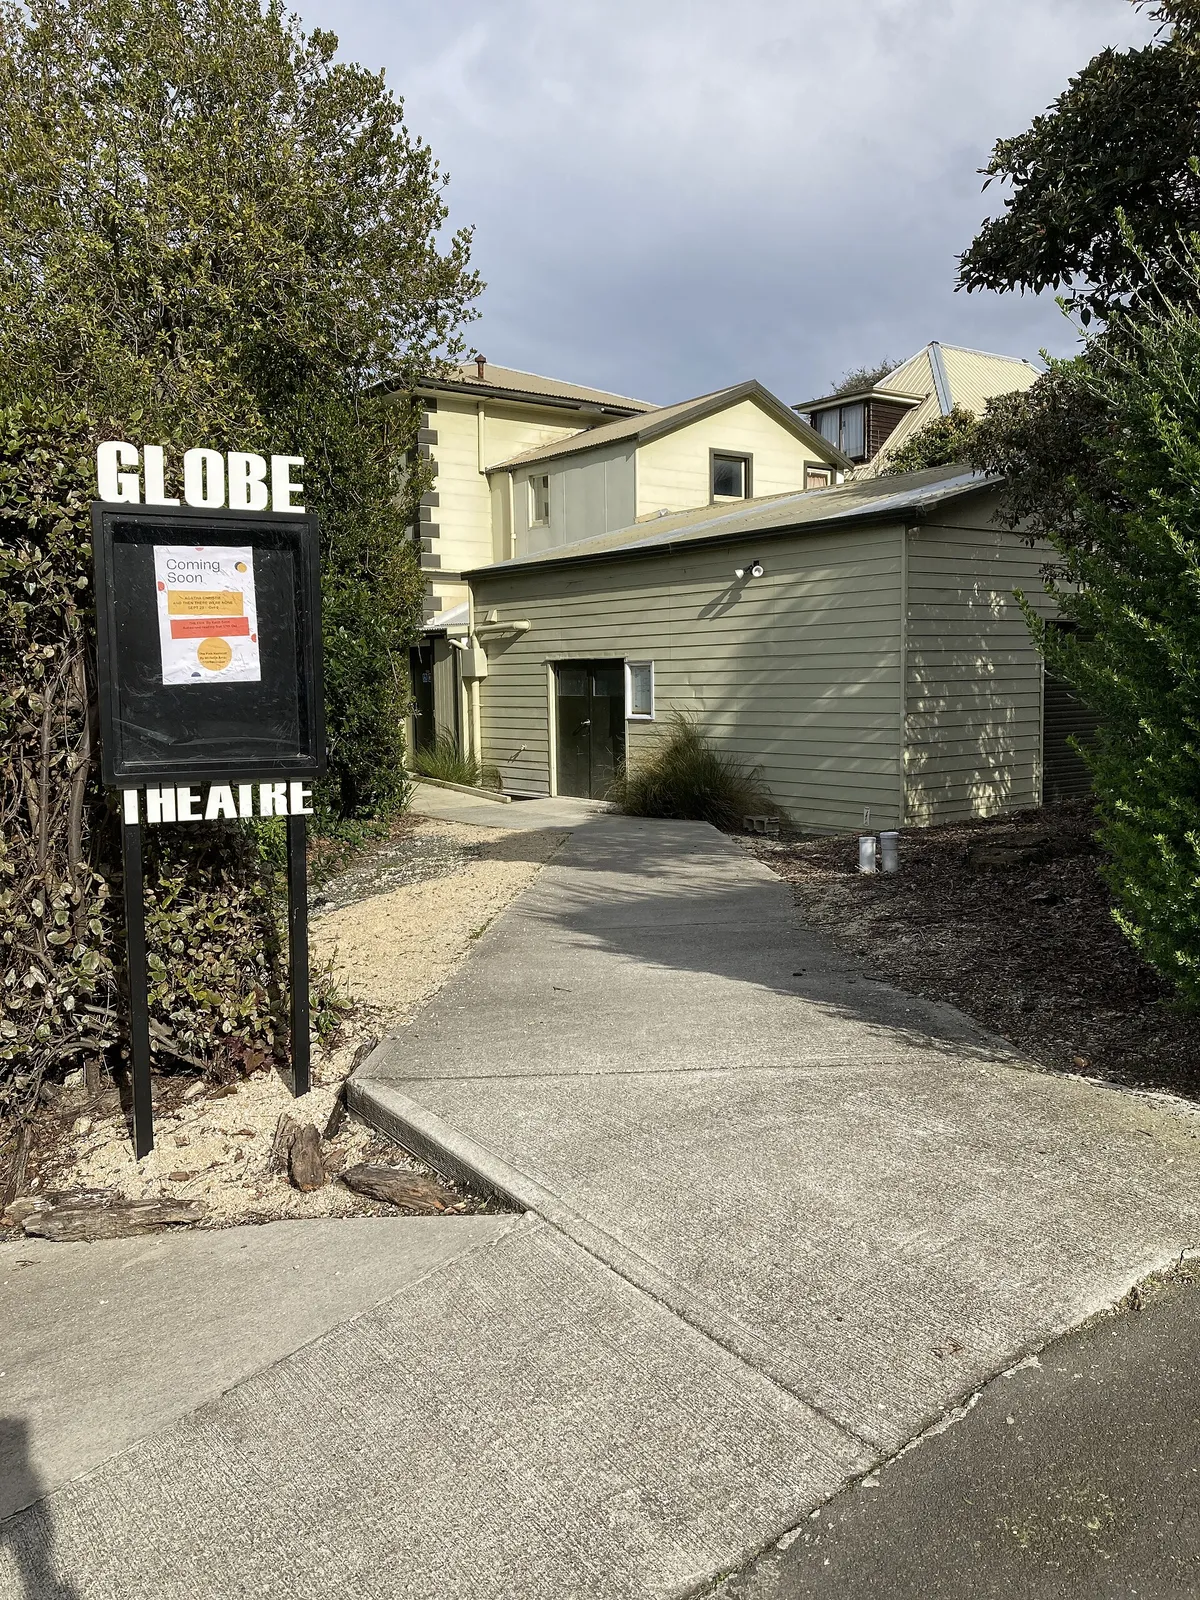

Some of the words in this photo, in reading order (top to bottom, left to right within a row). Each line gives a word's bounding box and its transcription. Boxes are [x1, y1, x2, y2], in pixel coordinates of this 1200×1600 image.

[97, 440, 306, 514] GLOBE
[166, 558, 221, 573] Coming
[167, 572, 204, 583] Soon
[117, 778, 314, 825] THEATRE
